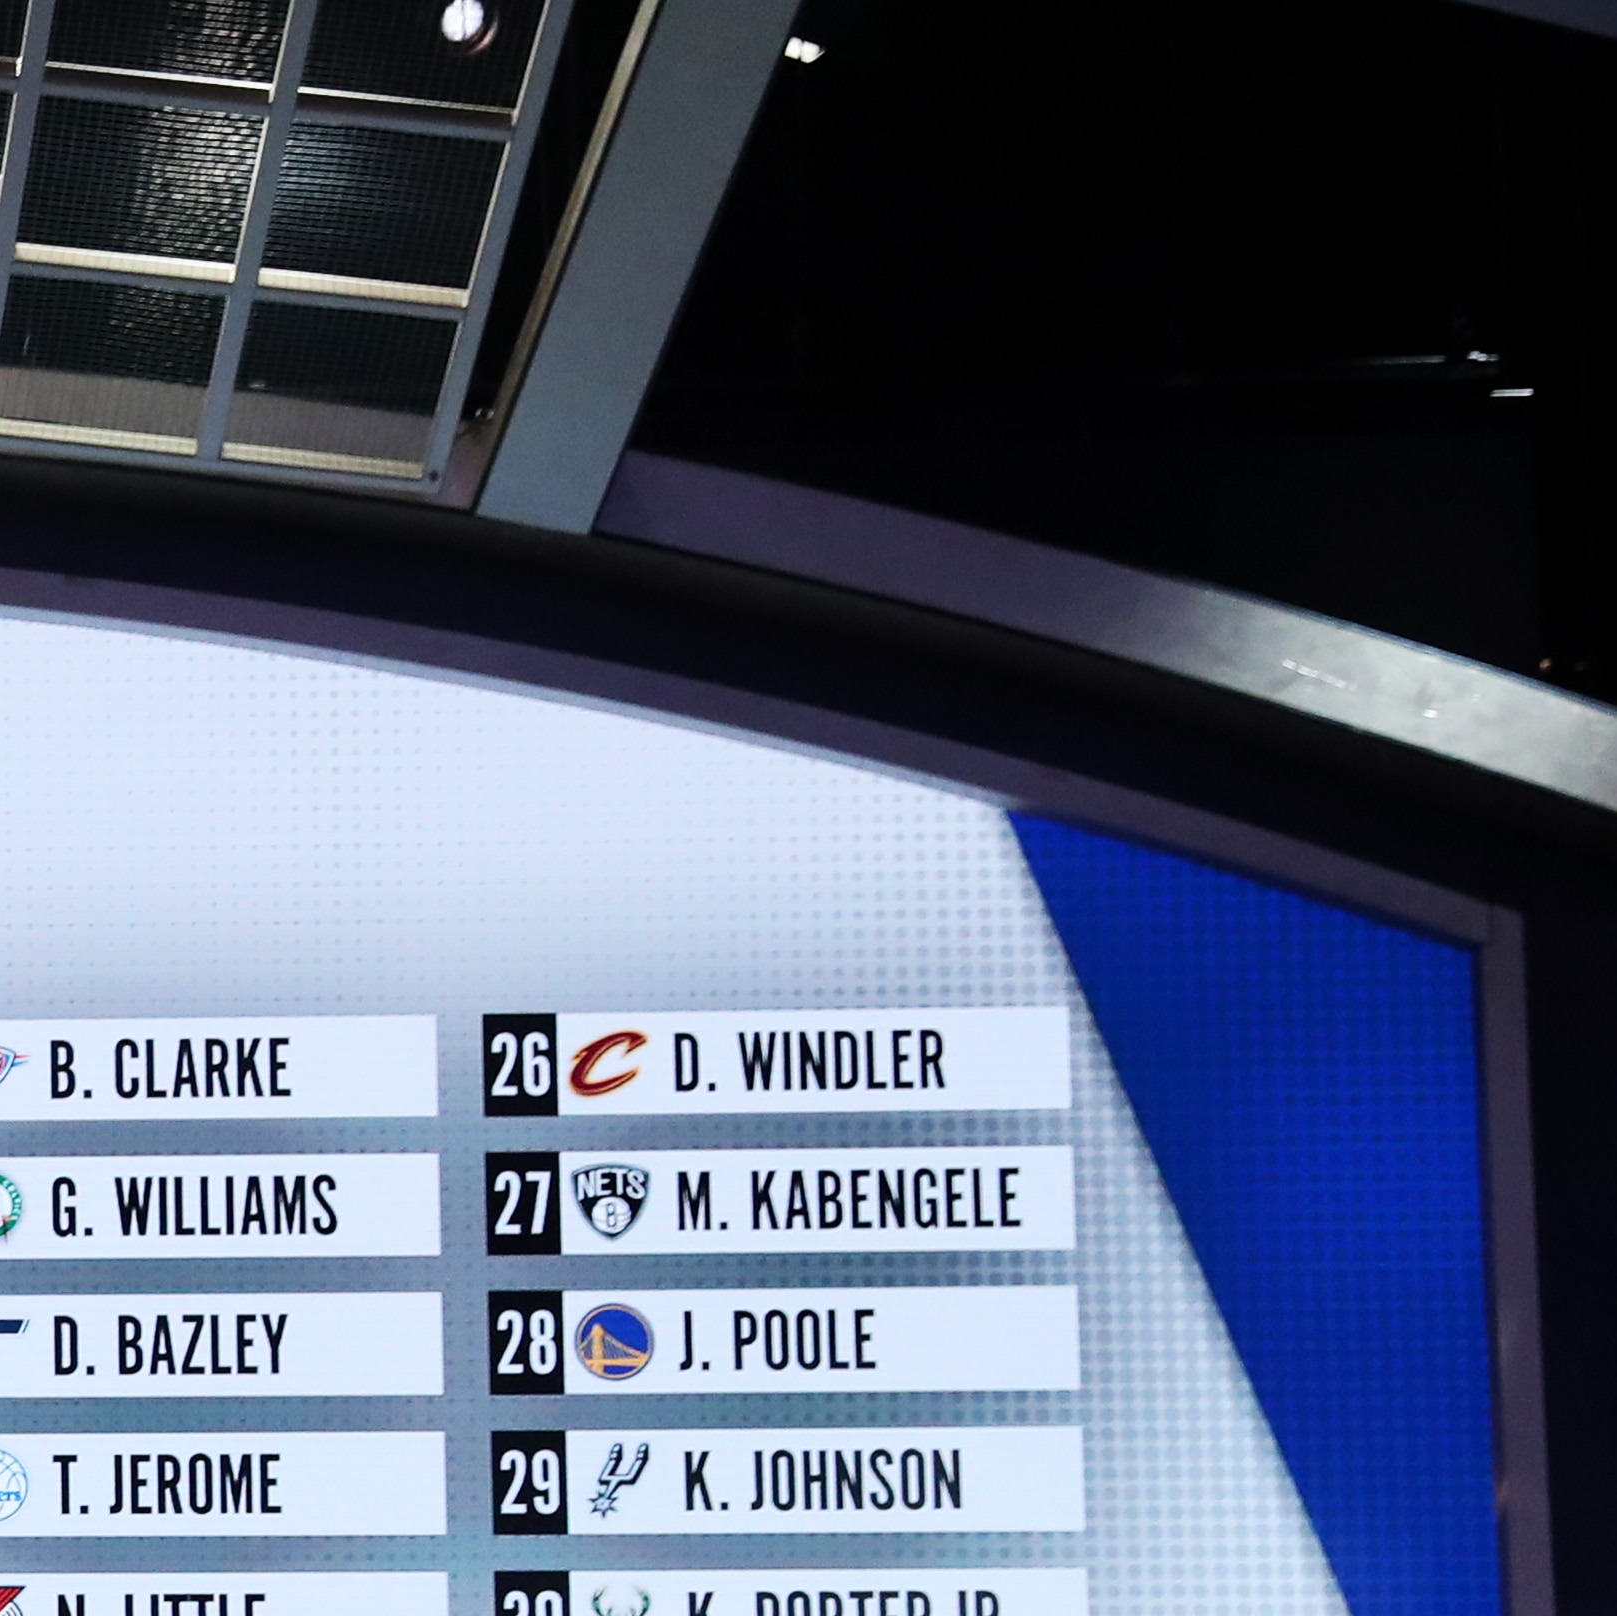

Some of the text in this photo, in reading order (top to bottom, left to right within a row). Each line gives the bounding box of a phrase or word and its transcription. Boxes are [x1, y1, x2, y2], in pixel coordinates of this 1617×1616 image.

[50, 1039, 92, 1099] B.
[114, 1037, 292, 1099] CLARKE
[491, 1029, 945, 1097] 26 D. WINDLER
[52, 1176, 93, 1238] G.
[114, 1174, 338, 1236] WILLIAMS
[494, 1167, 1021, 1235] 27 M. KABENGELE
[576, 1169, 646, 1201] NETS
[53, 1315, 95, 1376] D.
[118, 1313, 288, 1375] BAZLEY
[496, 1308, 876, 1375] 28 J. POOLE
[52, 1454, 89, 1515] T.
[109, 1452, 282, 1515] JEROME
[500, 1448, 961, 1515] 29 K. JOHNSON
